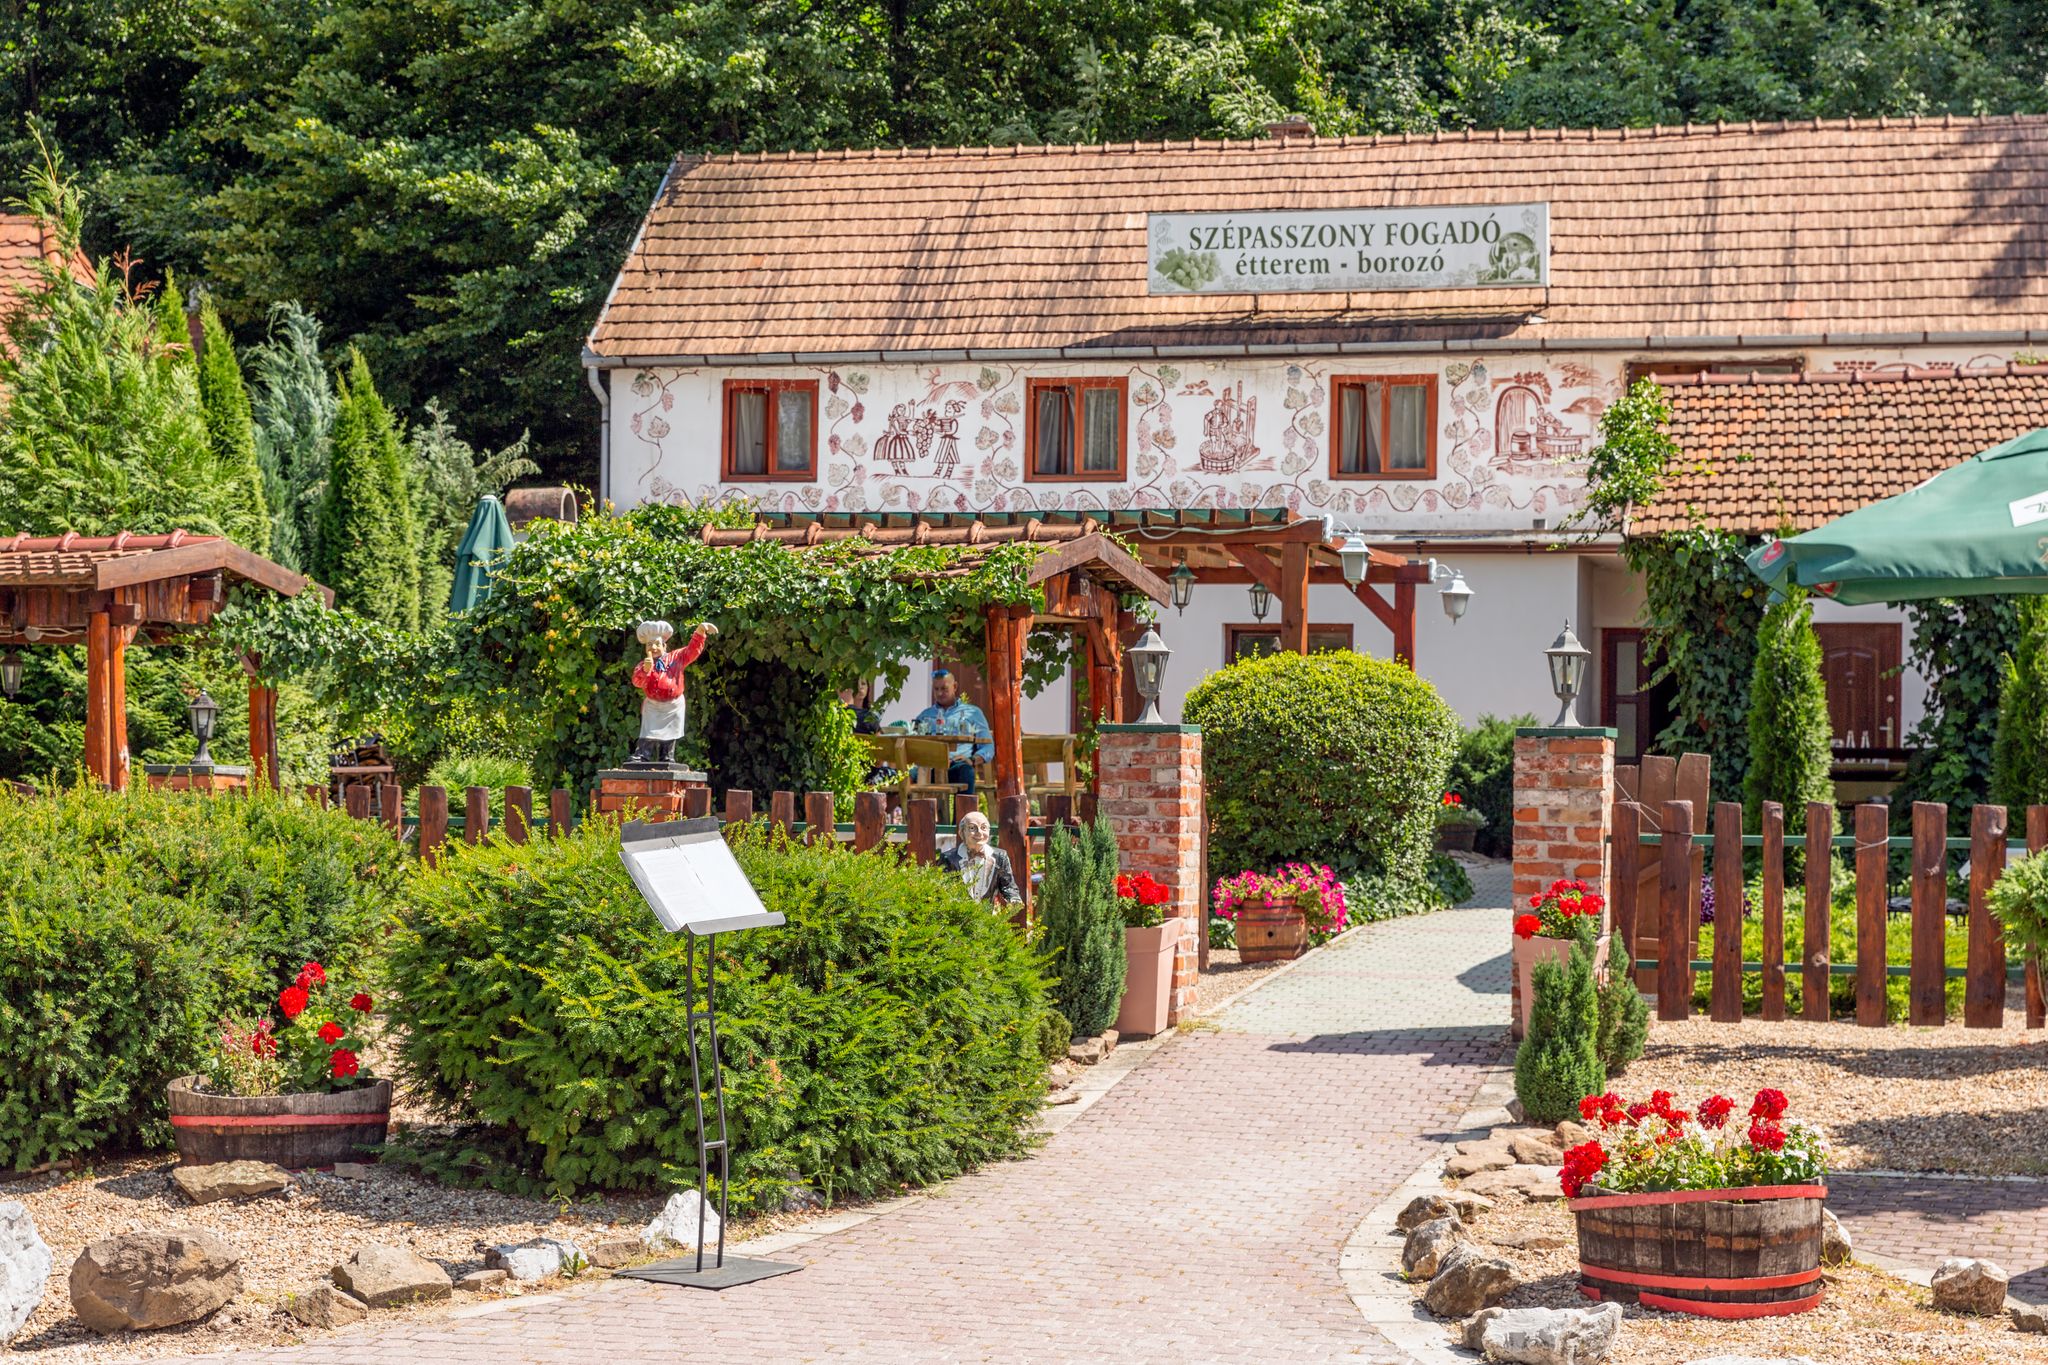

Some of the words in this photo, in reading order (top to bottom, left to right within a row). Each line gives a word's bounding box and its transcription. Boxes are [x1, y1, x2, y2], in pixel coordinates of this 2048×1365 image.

[1189, 220, 1375, 251] SZÉPASSZONY
[1385, 213, 1501, 246] FOGADÓ
[1235, 253, 1330, 276] étterem
[1358, 249, 1445, 275] borozó
